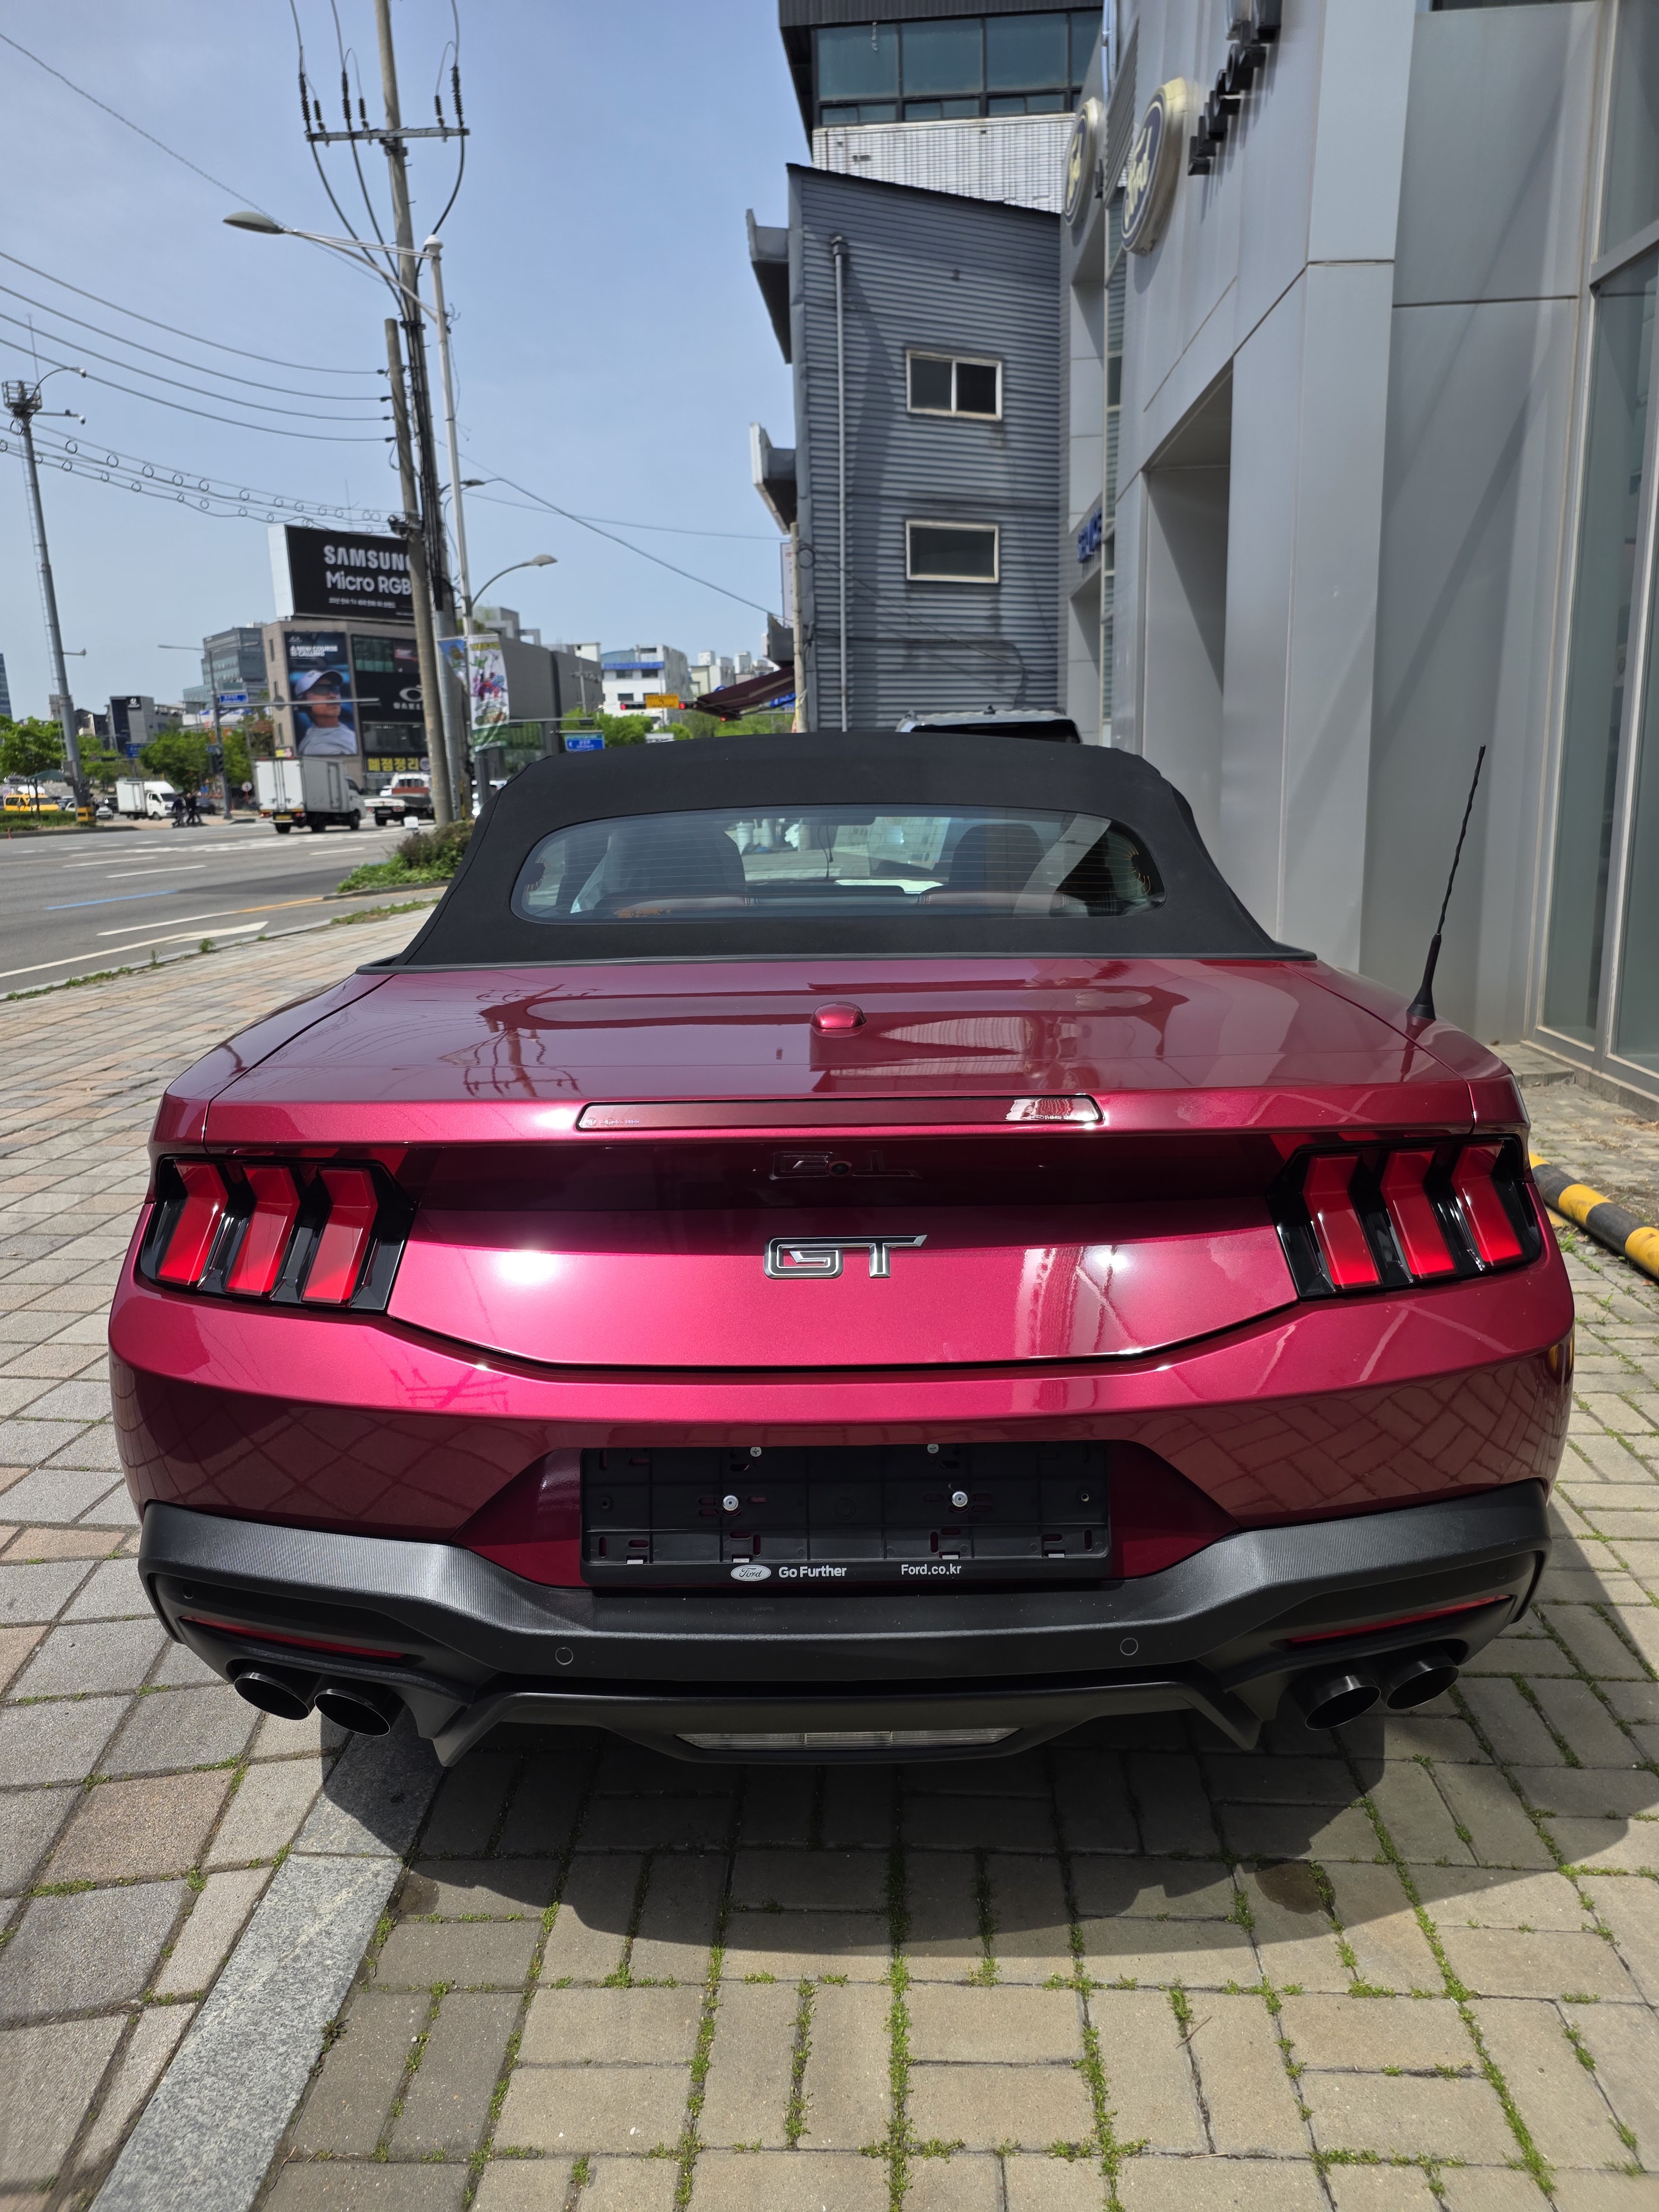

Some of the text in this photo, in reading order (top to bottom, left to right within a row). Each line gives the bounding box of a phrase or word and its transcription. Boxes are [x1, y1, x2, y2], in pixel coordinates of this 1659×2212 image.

[325, 570, 413, 596] Micro RGB
[764, 1234, 928, 1279] GT
[779, 1566, 797, 1578] Go
[800, 1564, 847, 1577] Further
[901, 1563, 962, 1575] Ford.co.kr
